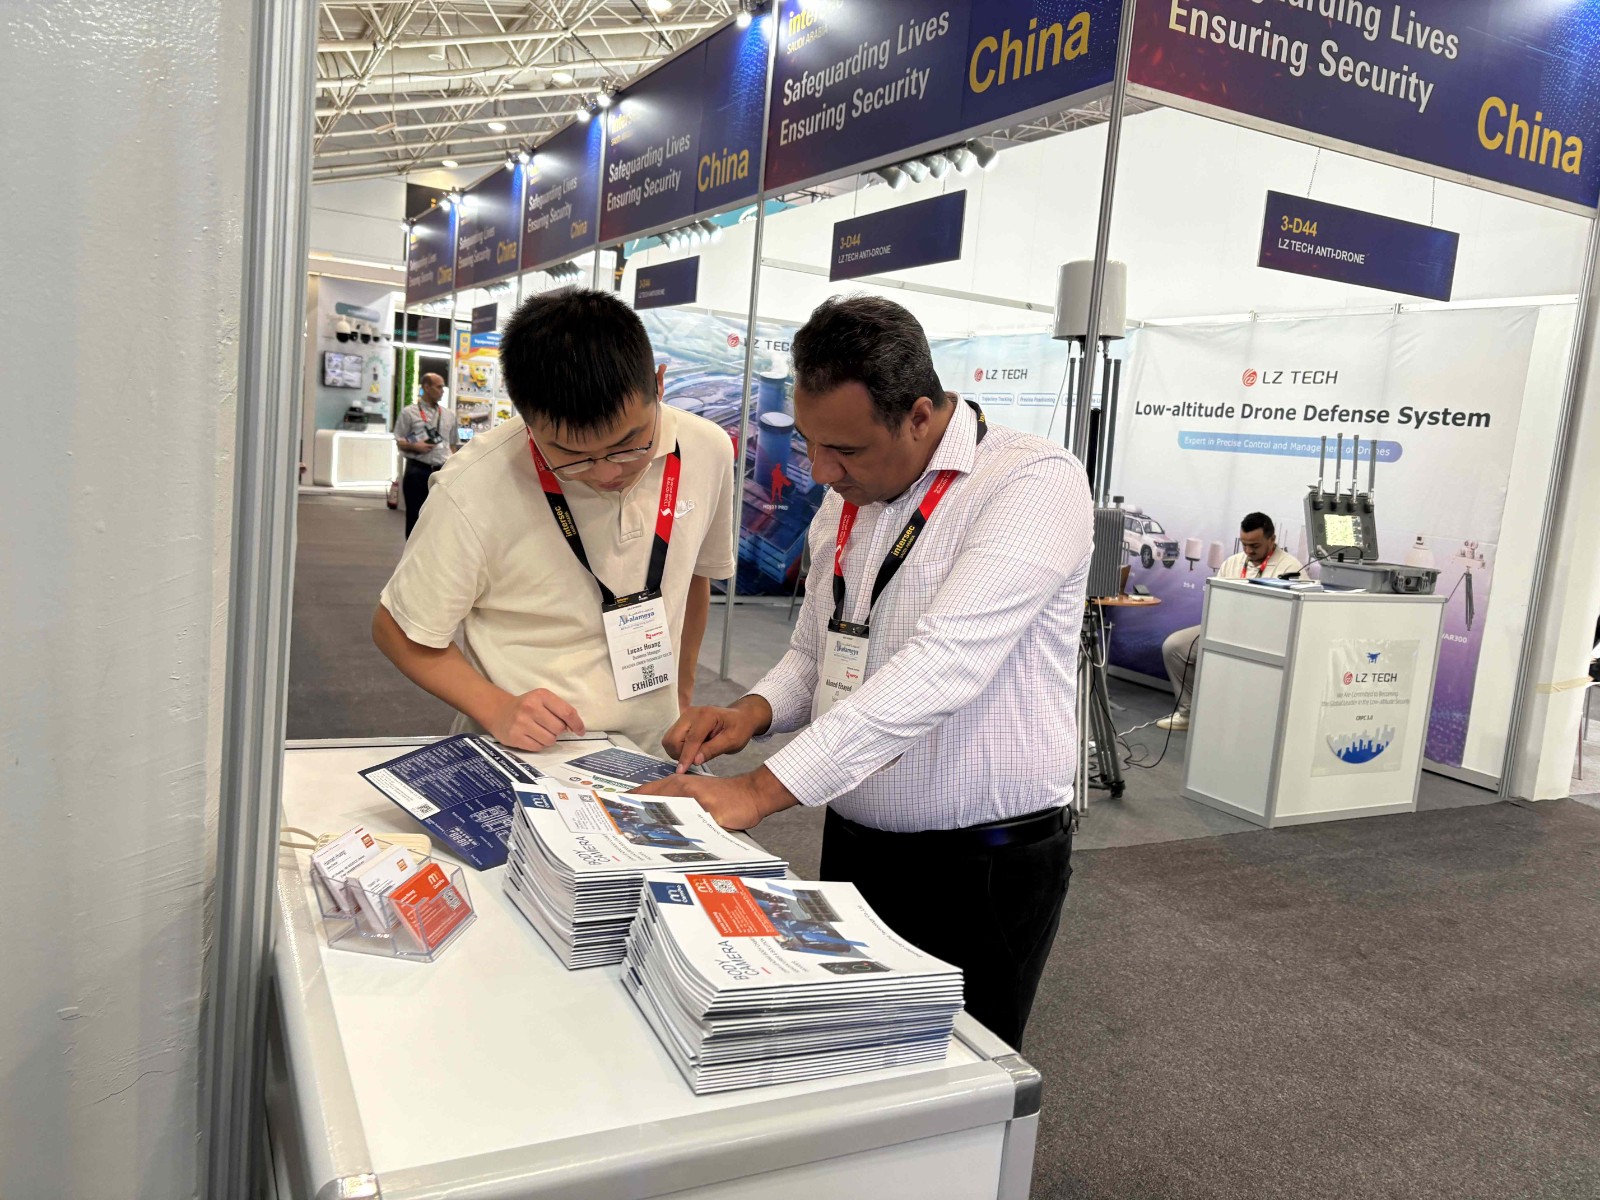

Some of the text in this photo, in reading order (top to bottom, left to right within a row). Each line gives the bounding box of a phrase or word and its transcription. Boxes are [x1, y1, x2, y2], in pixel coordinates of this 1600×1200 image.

[1391, 5, 1459, 60] Lives
[783, 11, 949, 106] Safeguarding Lives
[969, 11, 1091, 94] China
[1169, 0, 1308, 77] Ensuring
[1318, 39, 1435, 114] Security
[780, 66, 931, 147] Ensuring Security
[1477, 96, 1583, 175] China
[608, 147, 663, 183] Safeguarding
[666, 134, 690, 158] Lives
[697, 147, 749, 192] China
[606, 169, 681, 211] Ensuring Security
[571, 220, 588, 239] China
[1280, 215, 1317, 237] 3-D44
[840, 233, 861, 250] 3-D44
[1278, 238, 1365, 264] LZ TECH ANTI-DRONE
[844, 252, 859, 262] TECH
[765, 340, 789, 352] TEC
[986, 368, 1028, 380] LZ TECH
[1262, 370, 1338, 384] LZ TECH
[1135, 400, 1491, 429] Low-altitude Drone Defense System
[1184, 436, 1206, 446] Expert
[1207, 438, 1215, 446] in
[1216, 438, 1242, 448] Precise
[1244, 440, 1271, 449] Control
[1272, 441, 1288, 450] and
[1290, 442, 1340, 453] Manageen
[1358, 446, 1391, 456] Drnes
[555, 505, 572, 537] intersec
[891, 525, 916, 556] intersec
[627, 641, 661, 655] Lucas Huang
[632, 673, 669, 692] EXHIBITOR
[1355, 672, 1397, 682] LZ TECH
[715, 959, 749, 980] BODY
[718, 940, 760, 976] CAMERA
